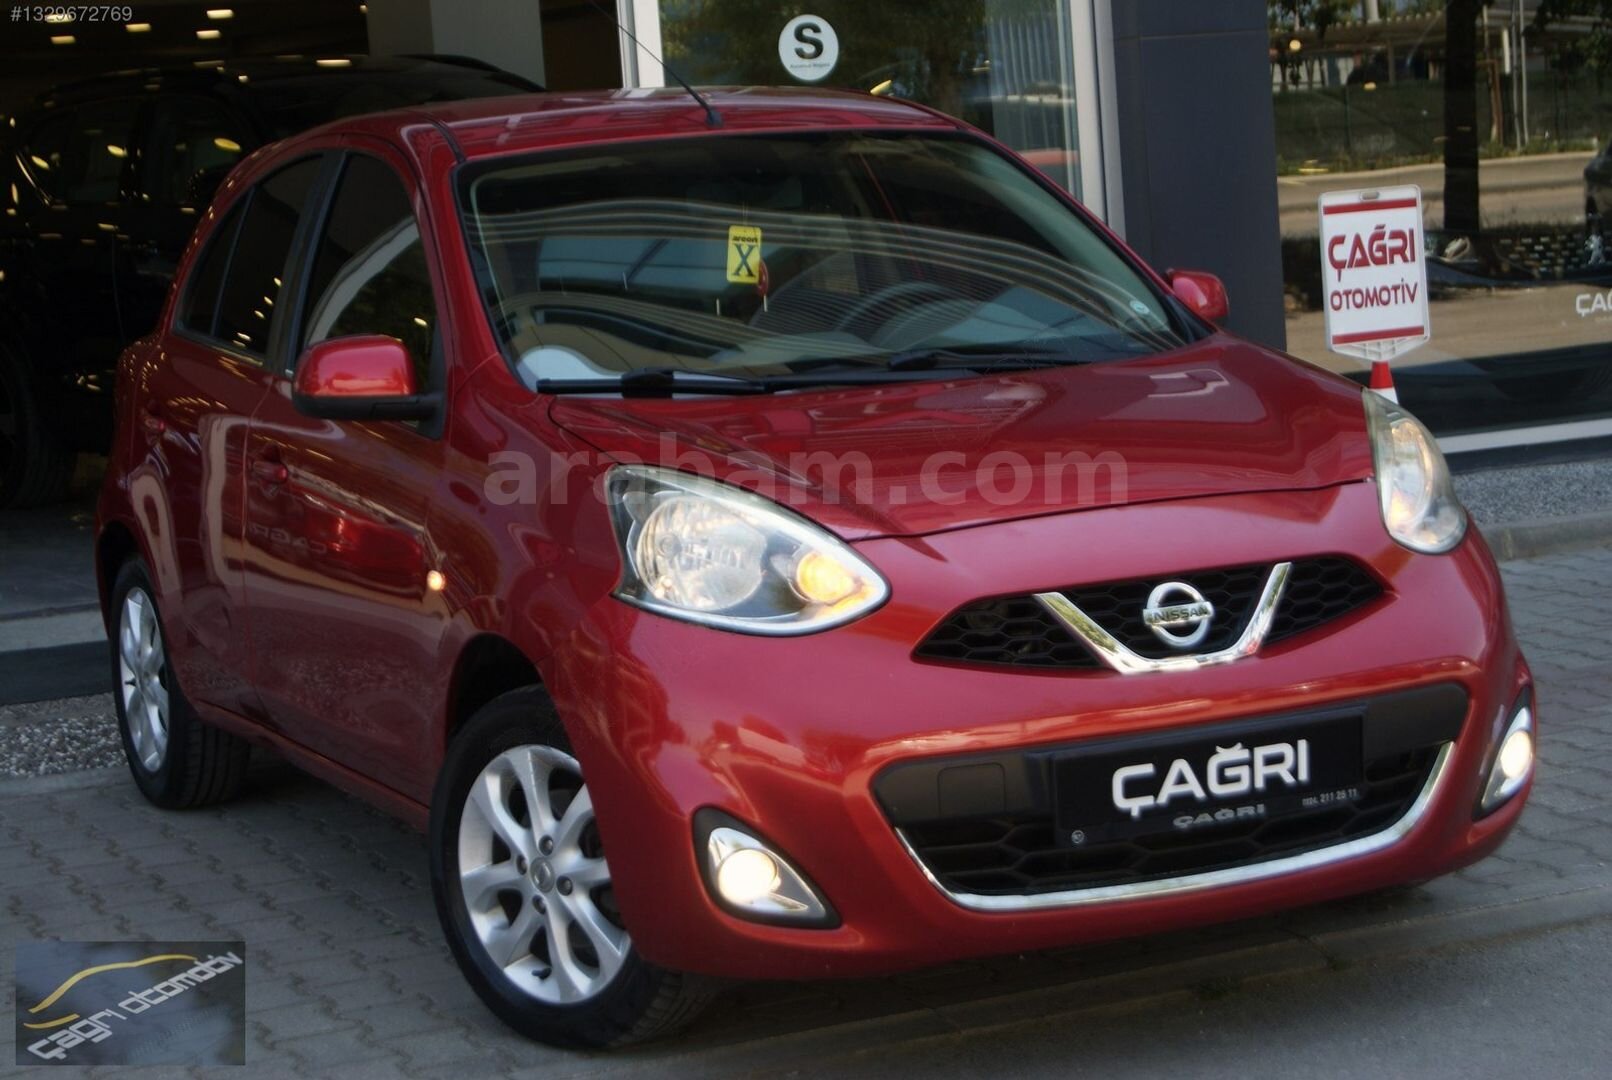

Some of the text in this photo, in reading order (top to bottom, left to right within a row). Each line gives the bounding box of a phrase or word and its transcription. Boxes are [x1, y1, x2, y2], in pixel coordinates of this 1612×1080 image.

[794, 22, 824, 60] S
[733, 243, 757, 277] X
[1328, 224, 1416, 283] ÇAĞRI
[1330, 277, 1418, 312] OTOMOTİV
[1152, 605, 1209, 622] NISSAN
[1112, 739, 1309, 817] ÇAĞRI
[1173, 803, 1265, 828] ÇAĞRI
